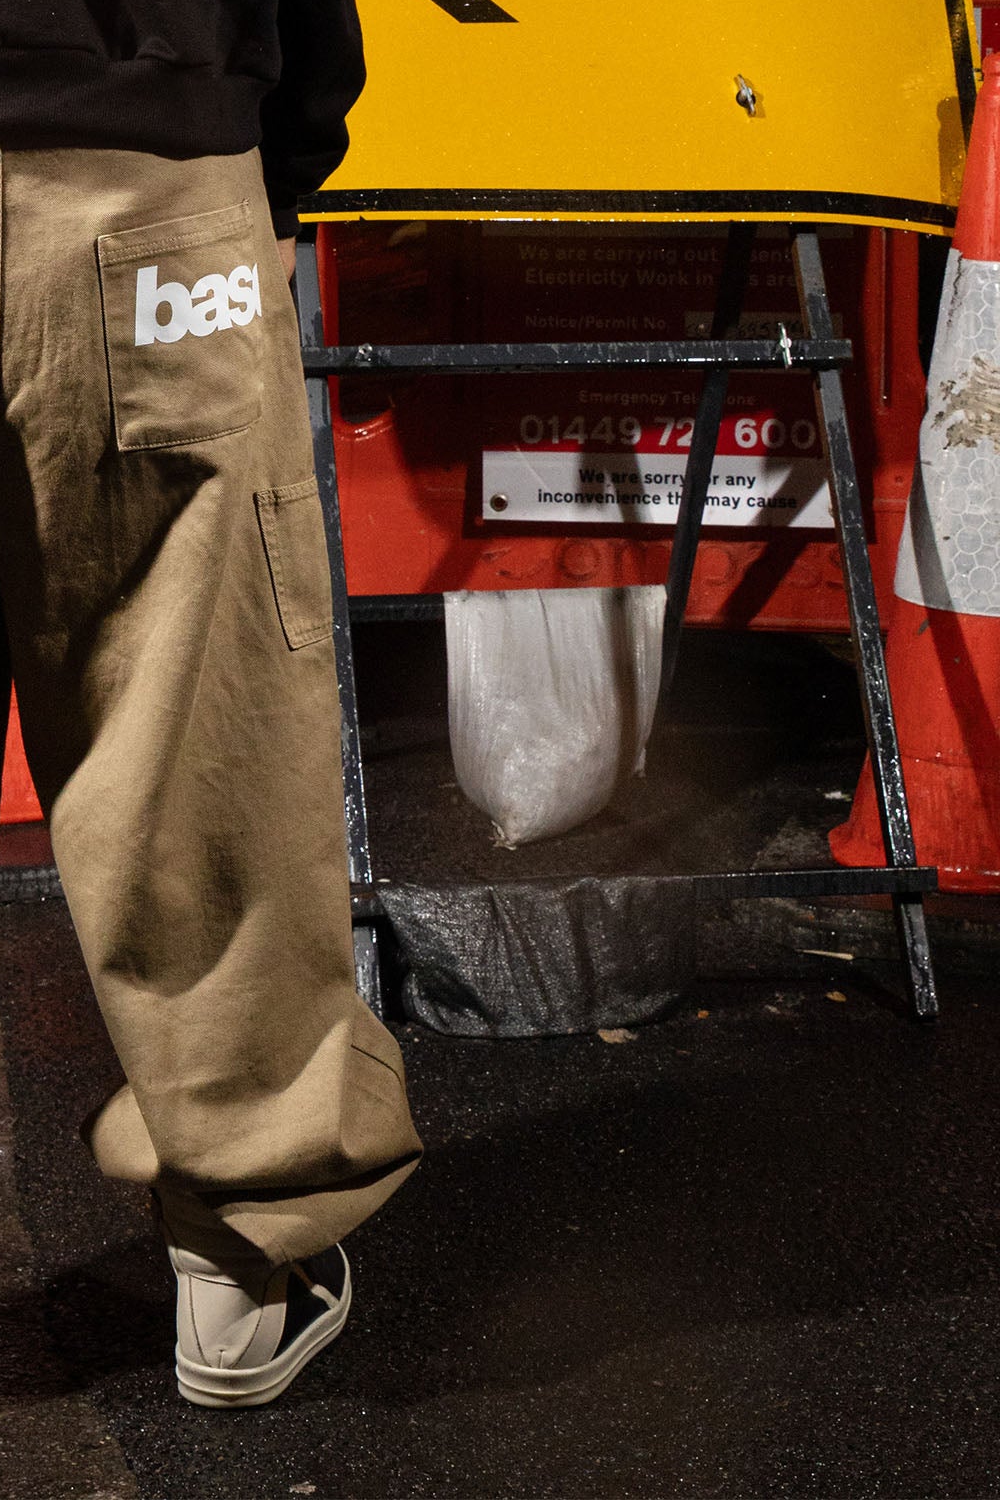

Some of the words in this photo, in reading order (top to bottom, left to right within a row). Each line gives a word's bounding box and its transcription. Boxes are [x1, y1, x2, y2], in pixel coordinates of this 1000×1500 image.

[135, 262, 262, 347] bas
[520, 414, 643, 446] 01449
[733, 417, 817, 449] 600
[579, 469, 604, 485] We
[610, 473, 638, 485] are
[725, 475, 756, 488] any
[538, 489, 661, 505] inconvenience
[705, 495, 740, 509] may
[746, 495, 798, 509] cause
